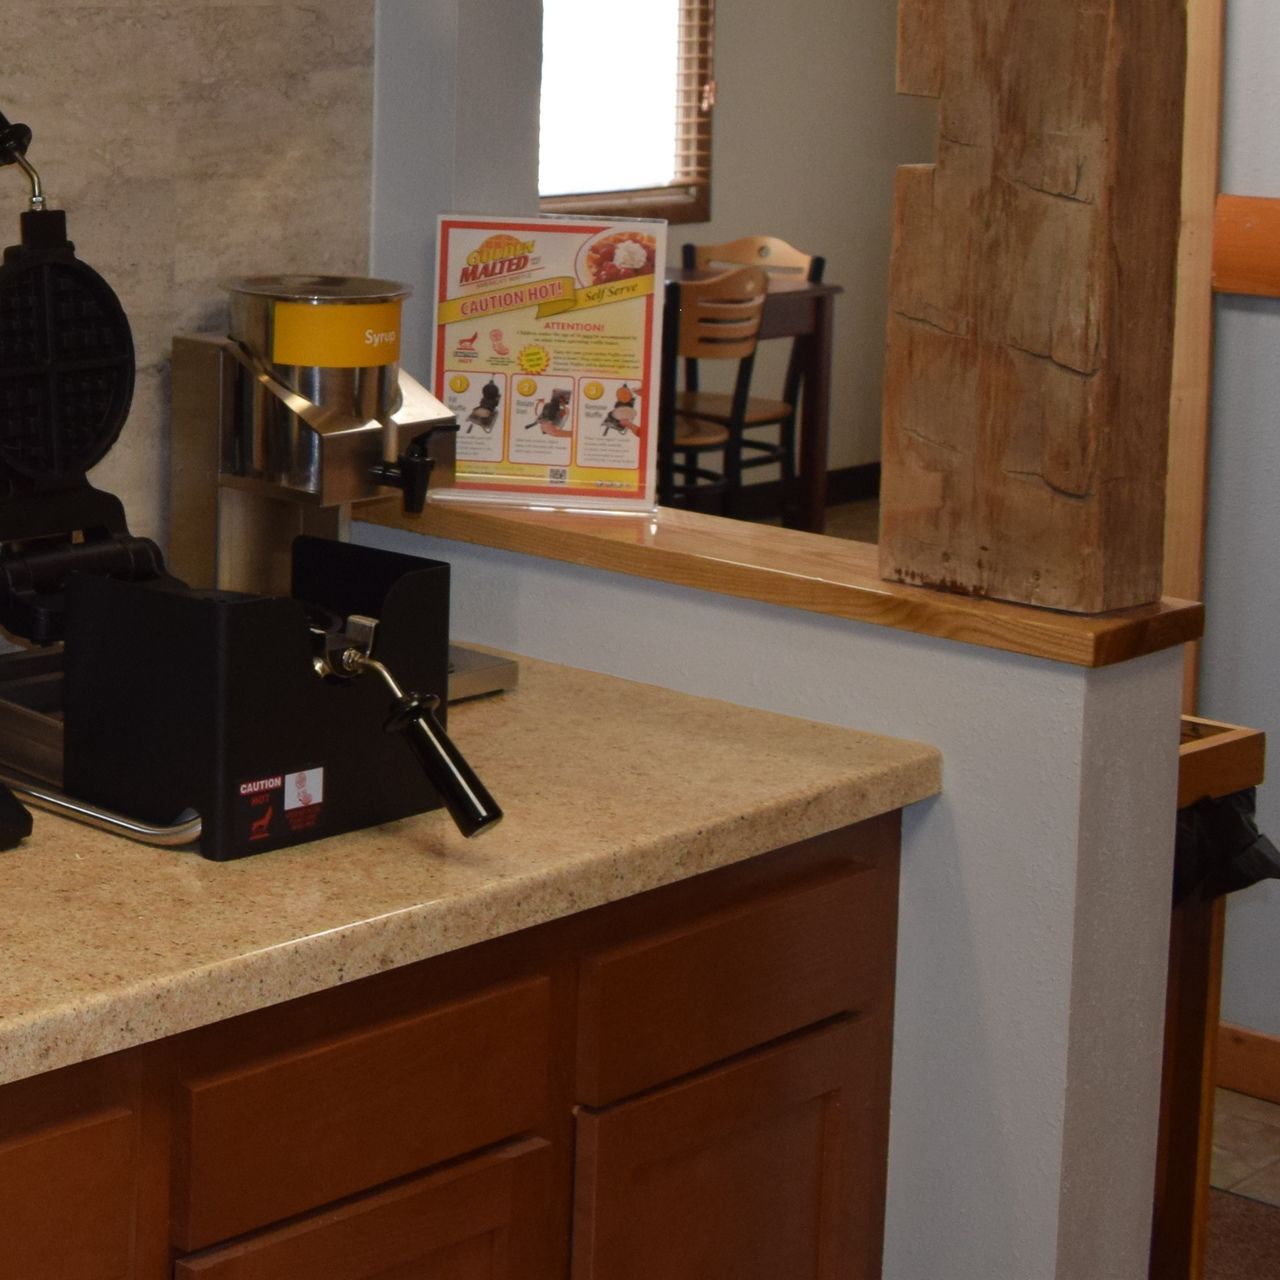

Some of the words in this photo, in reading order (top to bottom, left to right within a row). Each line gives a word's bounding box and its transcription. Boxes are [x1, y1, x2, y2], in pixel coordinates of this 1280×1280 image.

[459, 255, 529, 284] MALTED
[460, 289, 525, 316] CAUTION
[528, 281, 564, 302] HOT!
[584, 288, 608, 303] Self
[607, 282, 638, 298] Serve
[240, 776, 282, 794] CAUTION
